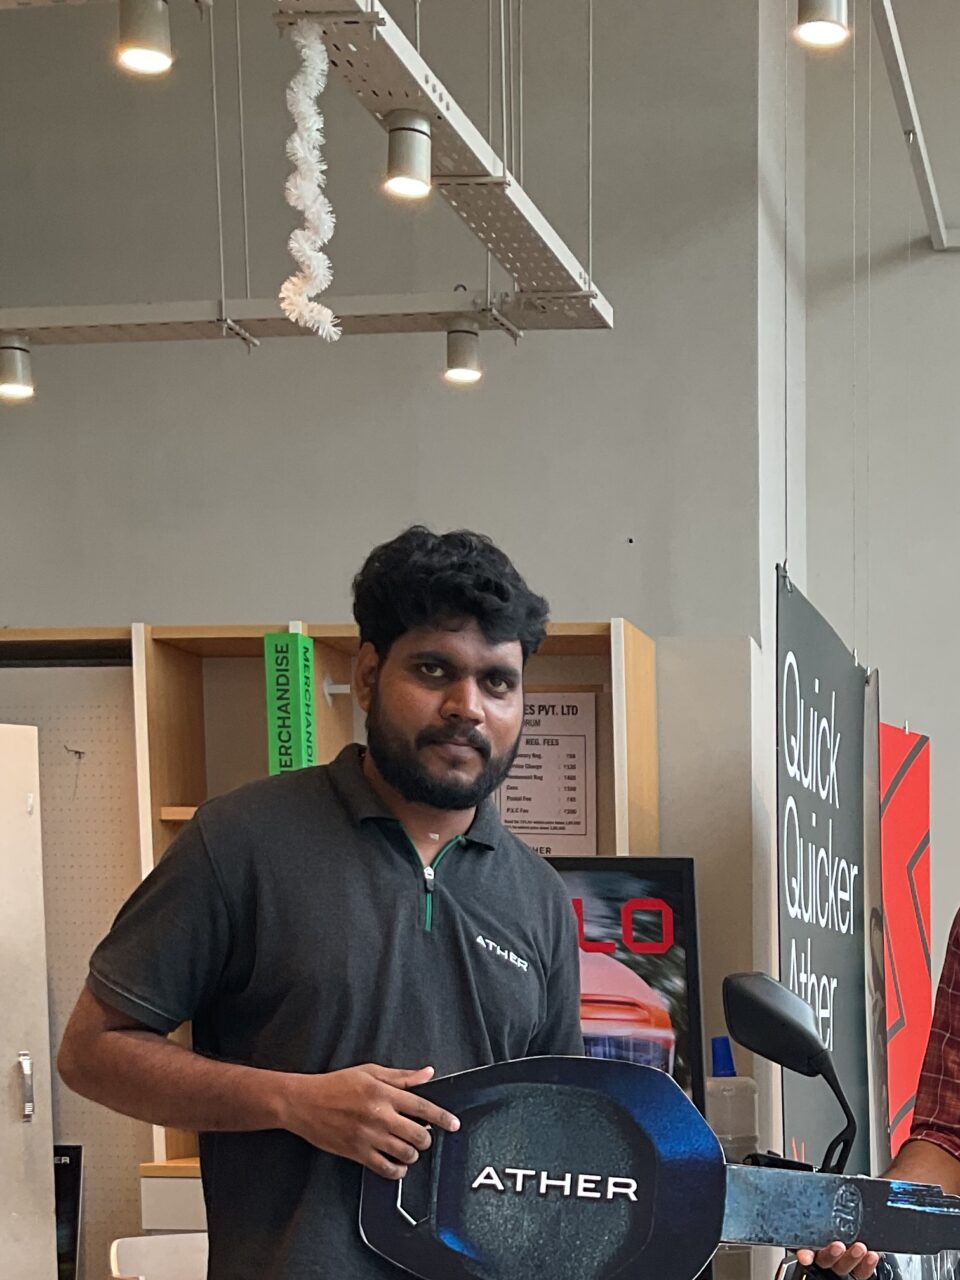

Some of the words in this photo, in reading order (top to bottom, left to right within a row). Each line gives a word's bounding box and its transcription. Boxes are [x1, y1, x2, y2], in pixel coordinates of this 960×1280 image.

[275, 643, 293, 771] ERCHANDISE
[303, 646, 313, 767] MERCHANDI
[524, 704, 536, 716] ES
[538, 704, 559, 716] PVT.
[561, 704, 579, 716] LTD
[524, 719, 541, 727] RUM
[783, 650, 841, 809] Quick
[530, 846, 551, 855] HER
[783, 795, 858, 935] Quicker
[571, 898, 674, 954] LO
[476, 935, 528, 972] ATHER
[471, 1165, 639, 1201] ATHER
